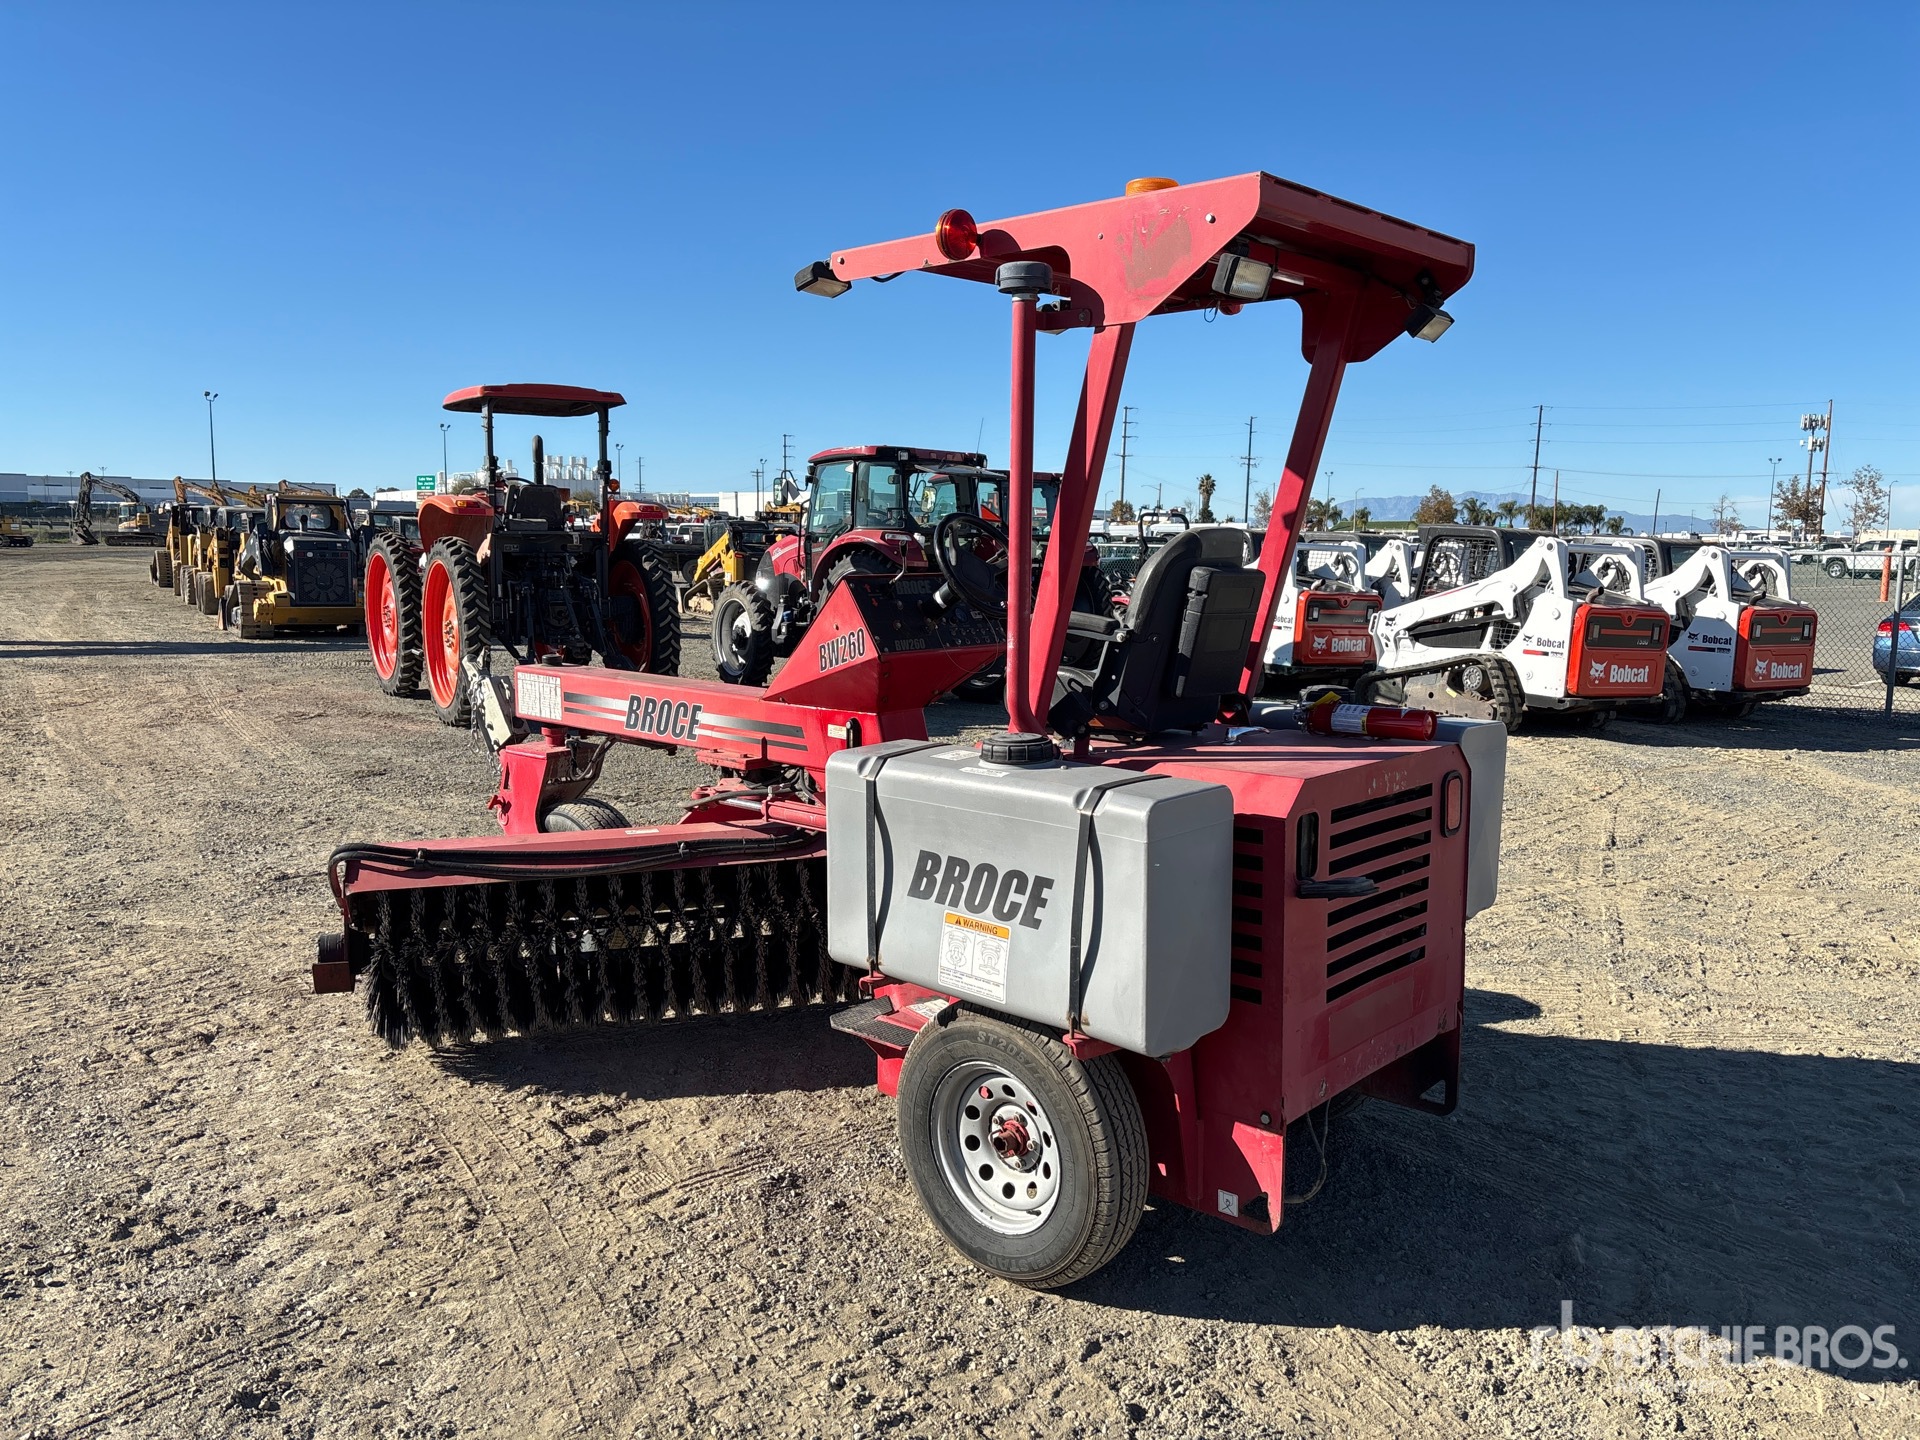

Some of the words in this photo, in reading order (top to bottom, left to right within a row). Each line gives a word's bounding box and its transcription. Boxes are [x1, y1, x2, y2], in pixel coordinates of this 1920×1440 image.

[895, 638, 926, 651] BW260
[1331, 637, 1367, 653] Bobcat
[1536, 637, 1565, 649] Bobcat
[1702, 634, 1732, 646] Bobcat
[818, 627, 866, 673] BW260
[1609, 664, 1649, 683] Bobcat
[1770, 662, 1803, 679] Bobcat
[624, 693, 704, 742] BROCE
[907, 849, 1055, 930] BROCE
[963, 919, 998, 935] WARNING
